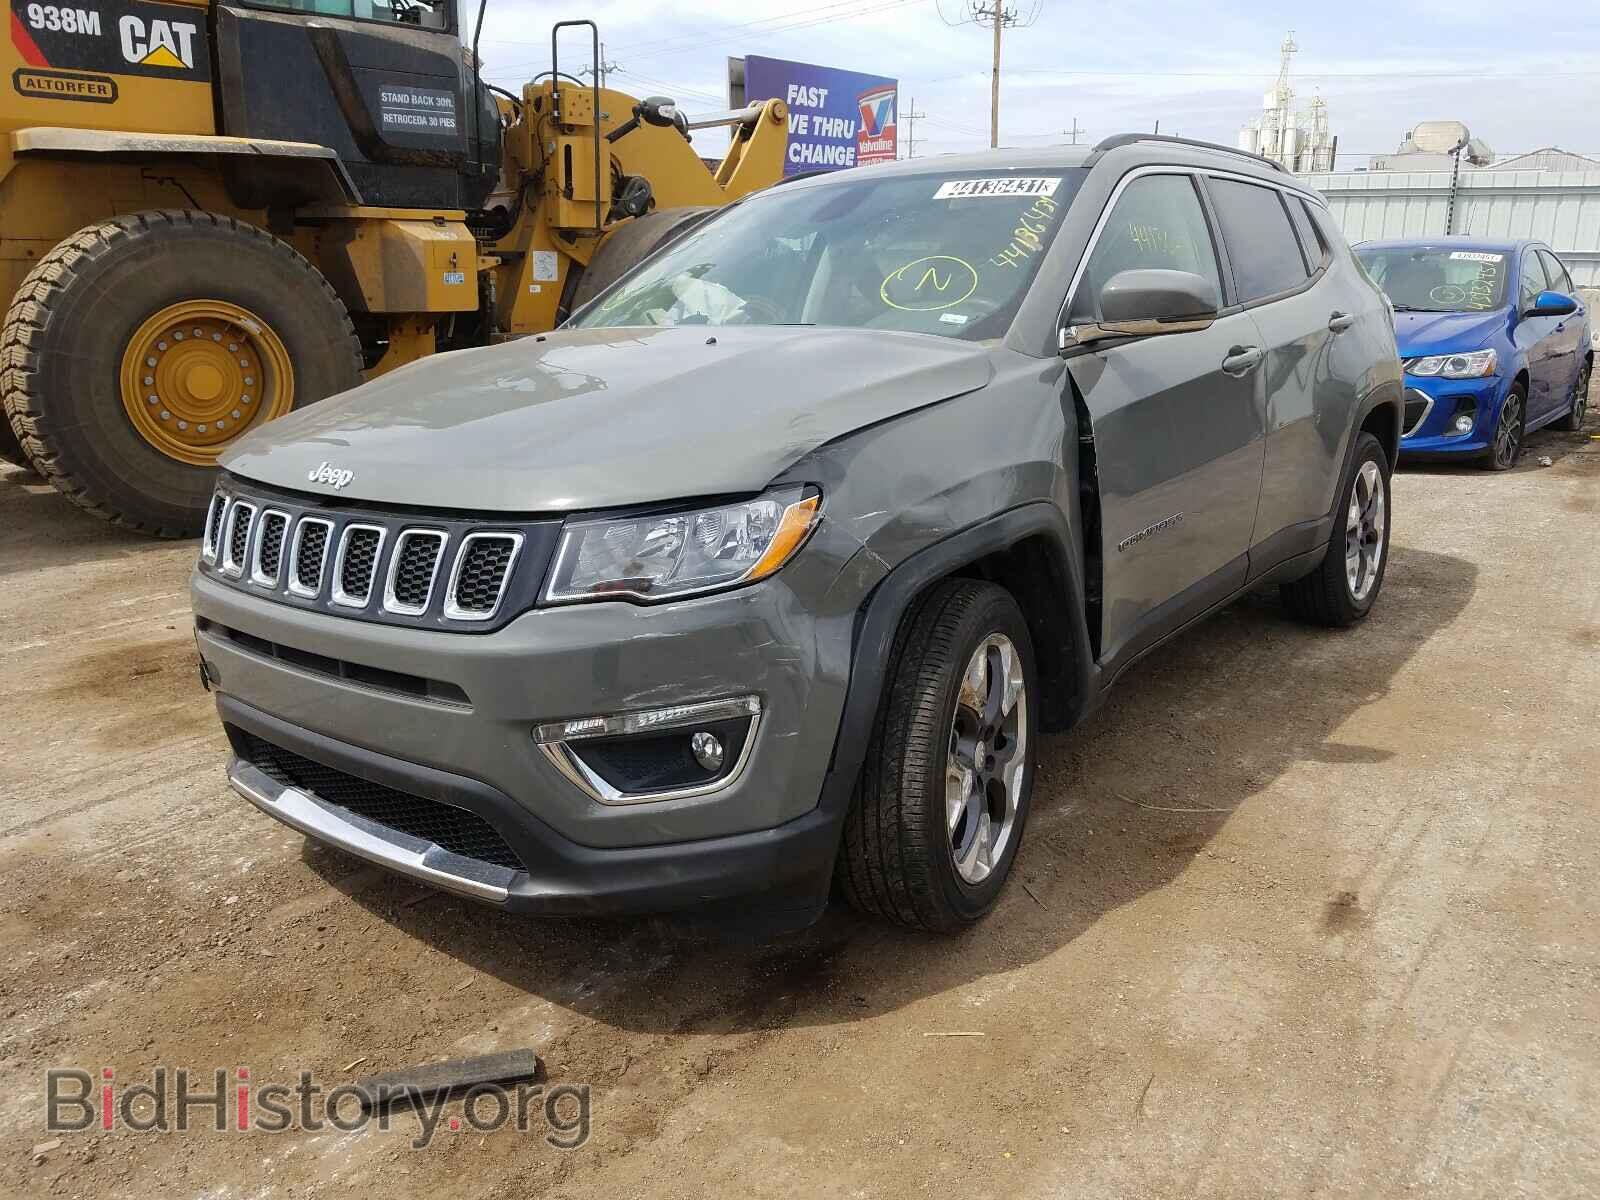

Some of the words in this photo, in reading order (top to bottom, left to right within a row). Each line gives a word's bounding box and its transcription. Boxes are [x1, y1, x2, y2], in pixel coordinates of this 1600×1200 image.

[27, 3, 101, 36] 938M
[119, 15, 197, 69] CAT
[25, 78, 108, 95] ALTORFER
[787, 84, 828, 108] FAST
[381, 92, 410, 105] STAND
[411, 94, 434, 106] BACK
[383, 113, 427, 126] RETROCEDA
[428, 116, 438, 127] 30
[439, 117, 456, 128] PIES
[813, 116, 855, 140] THRU
[788, 142, 856, 167] CHANGE
[859, 139, 893, 154] Valvoline
[308, 461, 354, 490] Jeep
